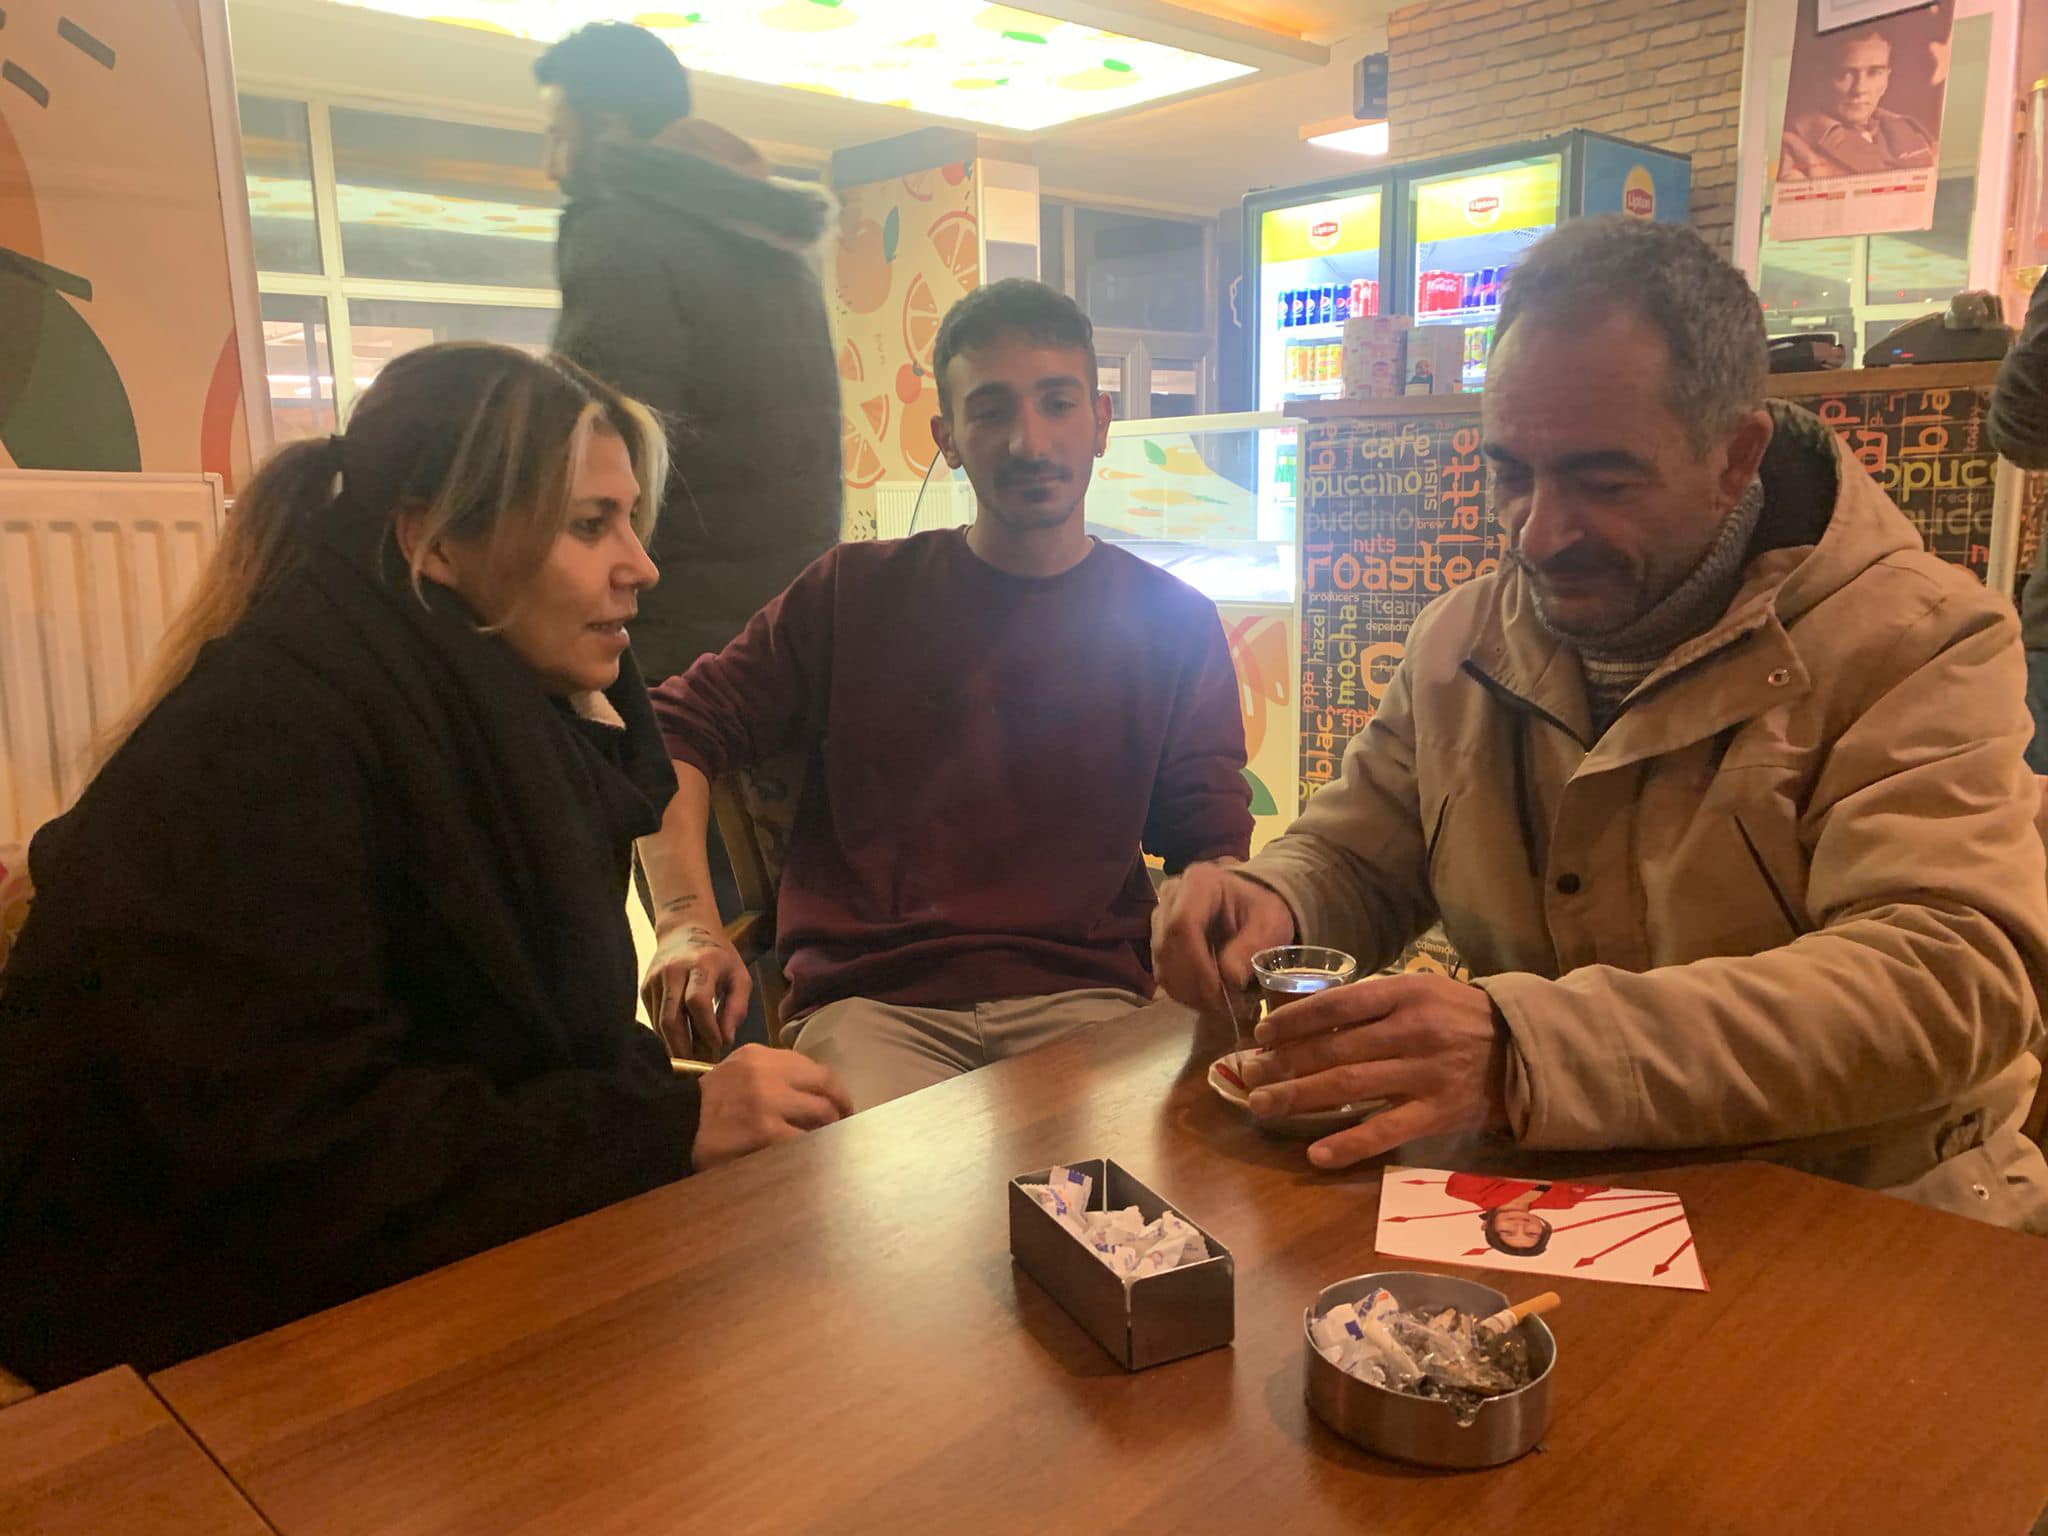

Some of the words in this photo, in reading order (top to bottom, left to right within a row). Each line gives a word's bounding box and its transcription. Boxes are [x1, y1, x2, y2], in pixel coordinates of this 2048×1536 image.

[1361, 424, 1431, 459] cafe
[1424, 459, 1438, 511] susu
[1437, 428, 1484, 546] latte
[1354, 533, 1396, 553] nuts
[1307, 608, 1326, 663] hazel
[1329, 604, 1357, 705] mocha
